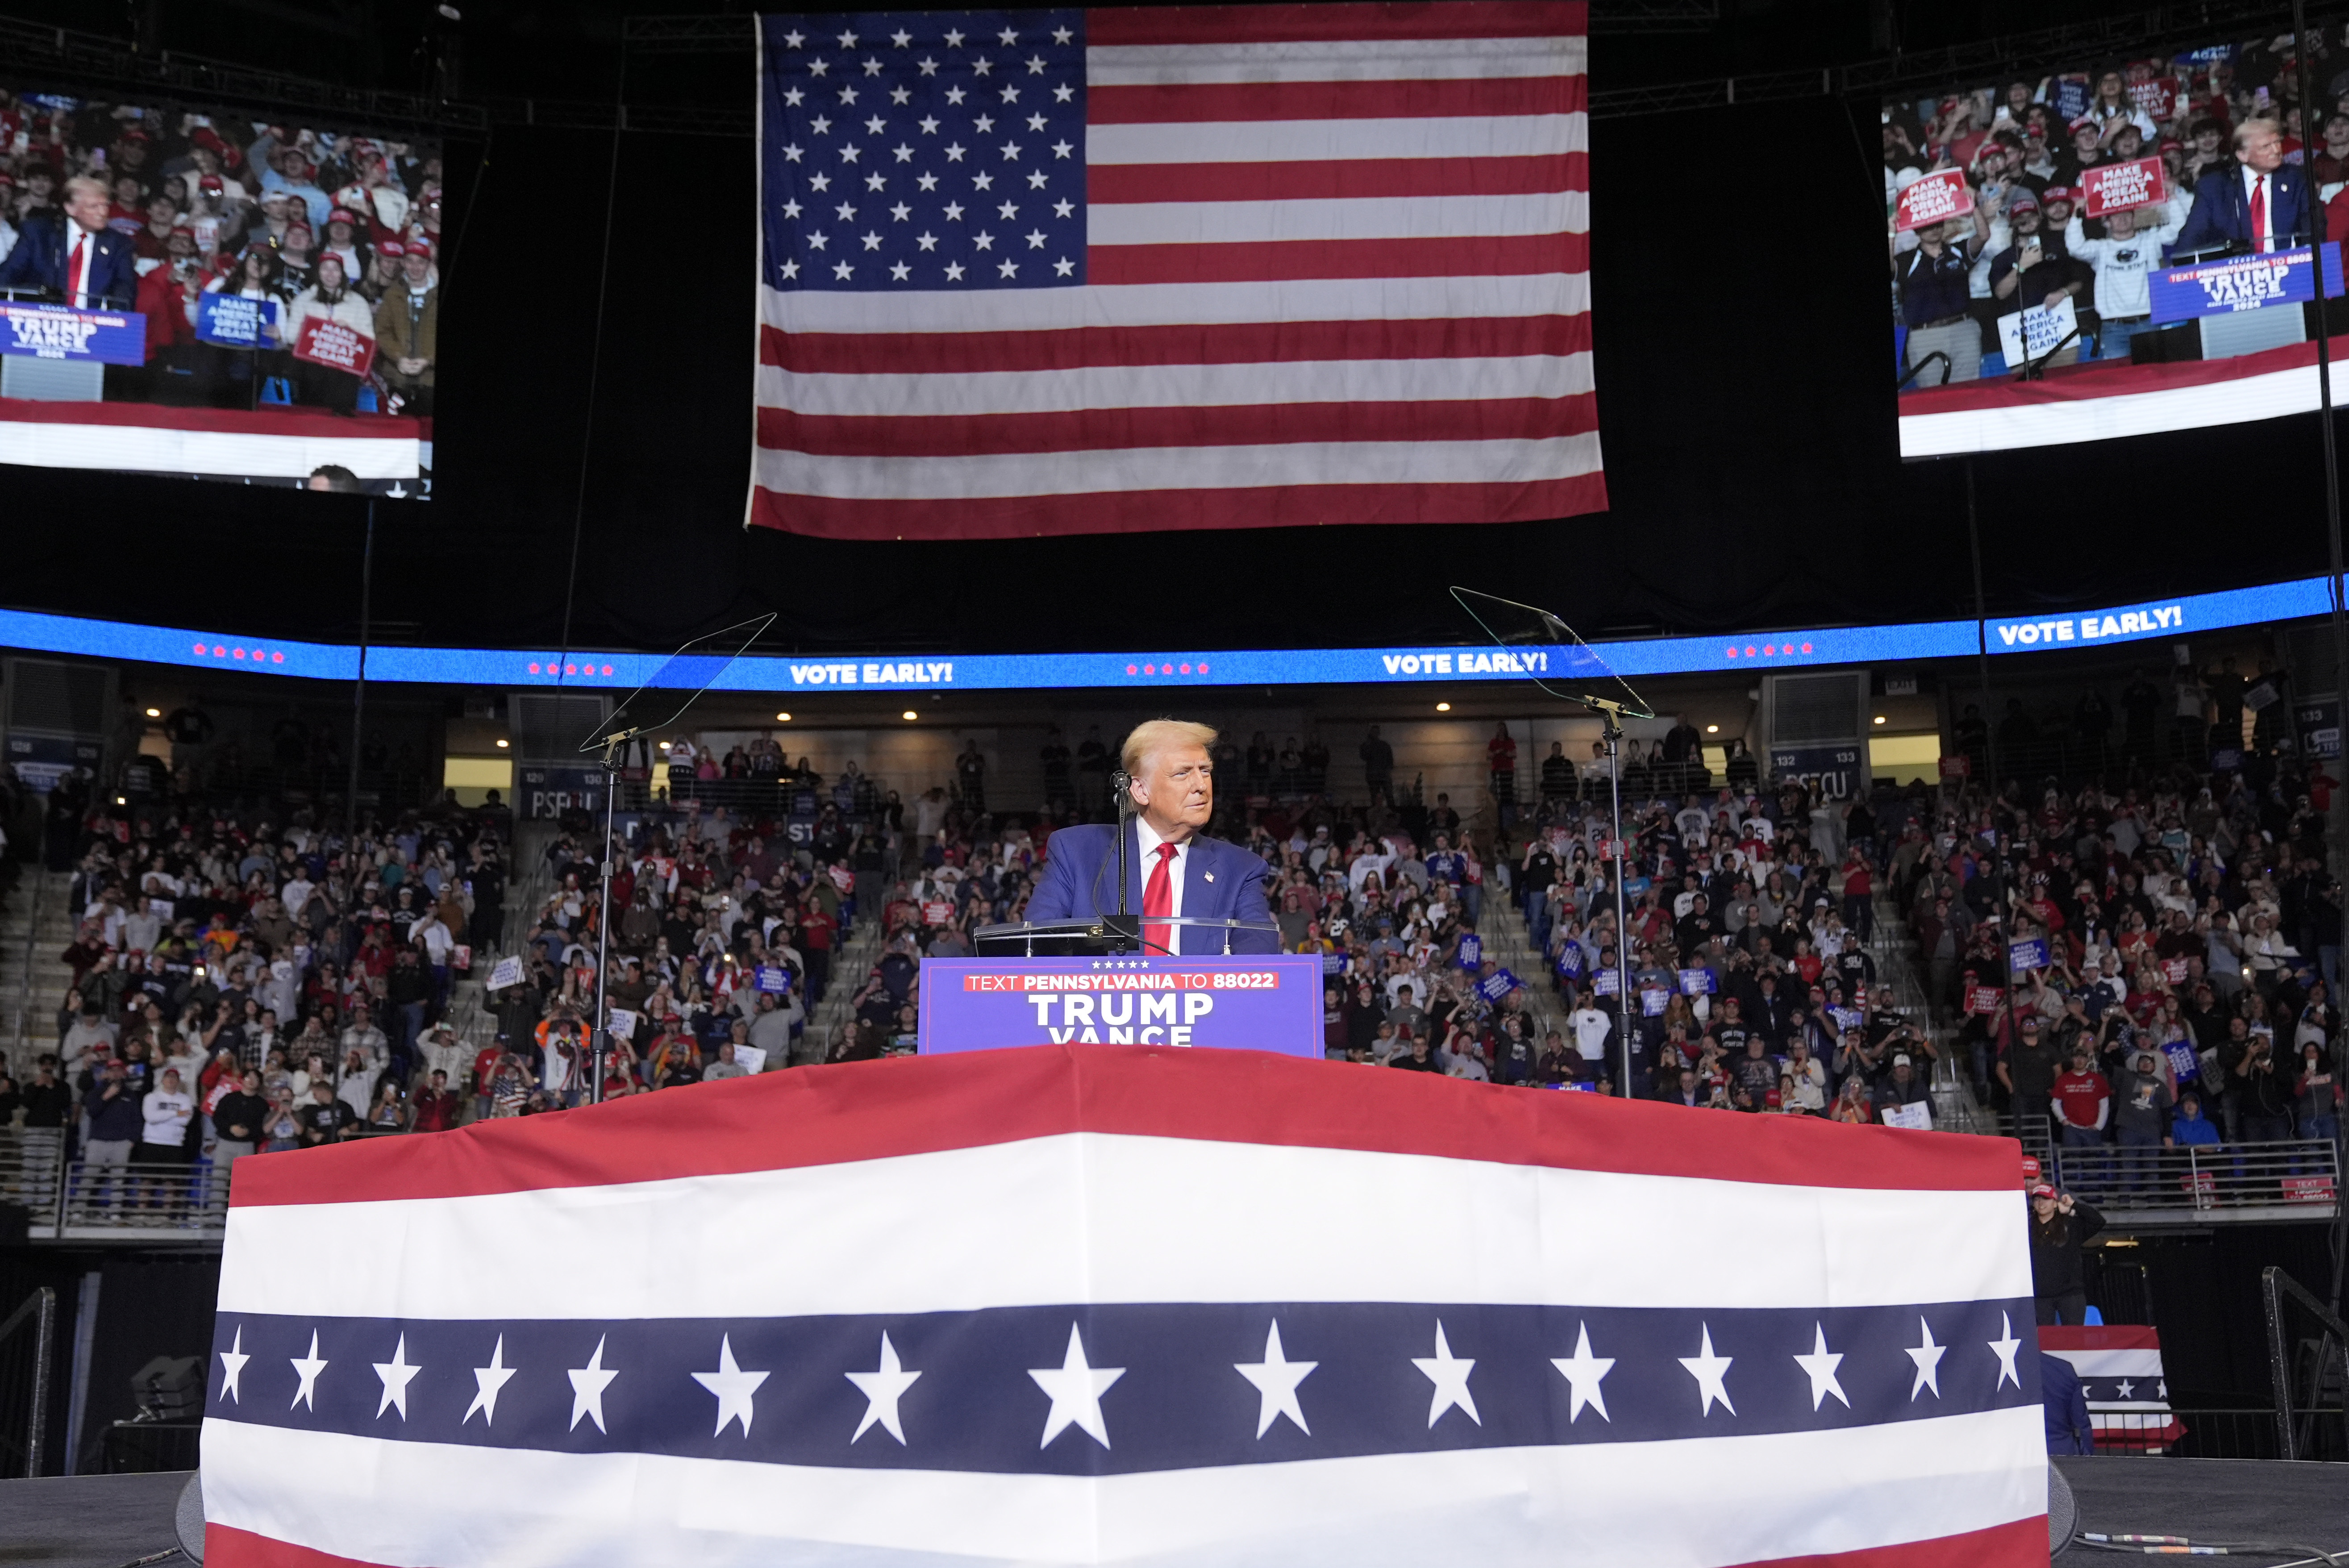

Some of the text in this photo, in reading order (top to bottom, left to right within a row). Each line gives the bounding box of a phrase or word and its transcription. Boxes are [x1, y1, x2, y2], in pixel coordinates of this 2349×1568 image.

[2092, 171, 2155, 193] AMERICA
[2102, 163, 2142, 181] MAKE
[1901, 183, 1959, 209] AMERICA
[1909, 177, 1945, 197] MAKE
[2101, 182, 2147, 200] GREAT
[1909, 192, 1952, 214] GREAT
[2101, 190, 2149, 210] AGAIN!
[1911, 201, 1956, 223] AGAIN!
[2170, 271, 2195, 283] TEXT
[2196, 260, 2270, 278] PENNSYLVANIA
[2199, 265, 2290, 293] TRUMP
[2211, 281, 2281, 302] VANCE
[219, 298, 258, 312] MAKE
[8, 315, 97, 336] TRUMP
[322, 323, 358, 341] MAKE
[2028, 326, 2058, 341] REAT
[17, 332, 87, 349] VANCE
[308, 328, 365, 354] AMERICA
[2030, 335, 2062, 351] GAIN!
[1998, 605, 2182, 646] VOTE EARLY!
[790, 663, 952, 684] VOTE EARLY!
[1383, 652, 1548, 674] VOTE EARLY!
[1777, 755, 1795, 766] 132
[1836, 750, 1855, 763] 133
[969, 973, 1274, 990] TEXT PENNSYLVANIA TO 88022
[1028, 993, 1213, 1026] TRUMP
[1048, 1026, 1192, 1048] VANCE
[2296, 1180, 2318, 1188] TEXT
